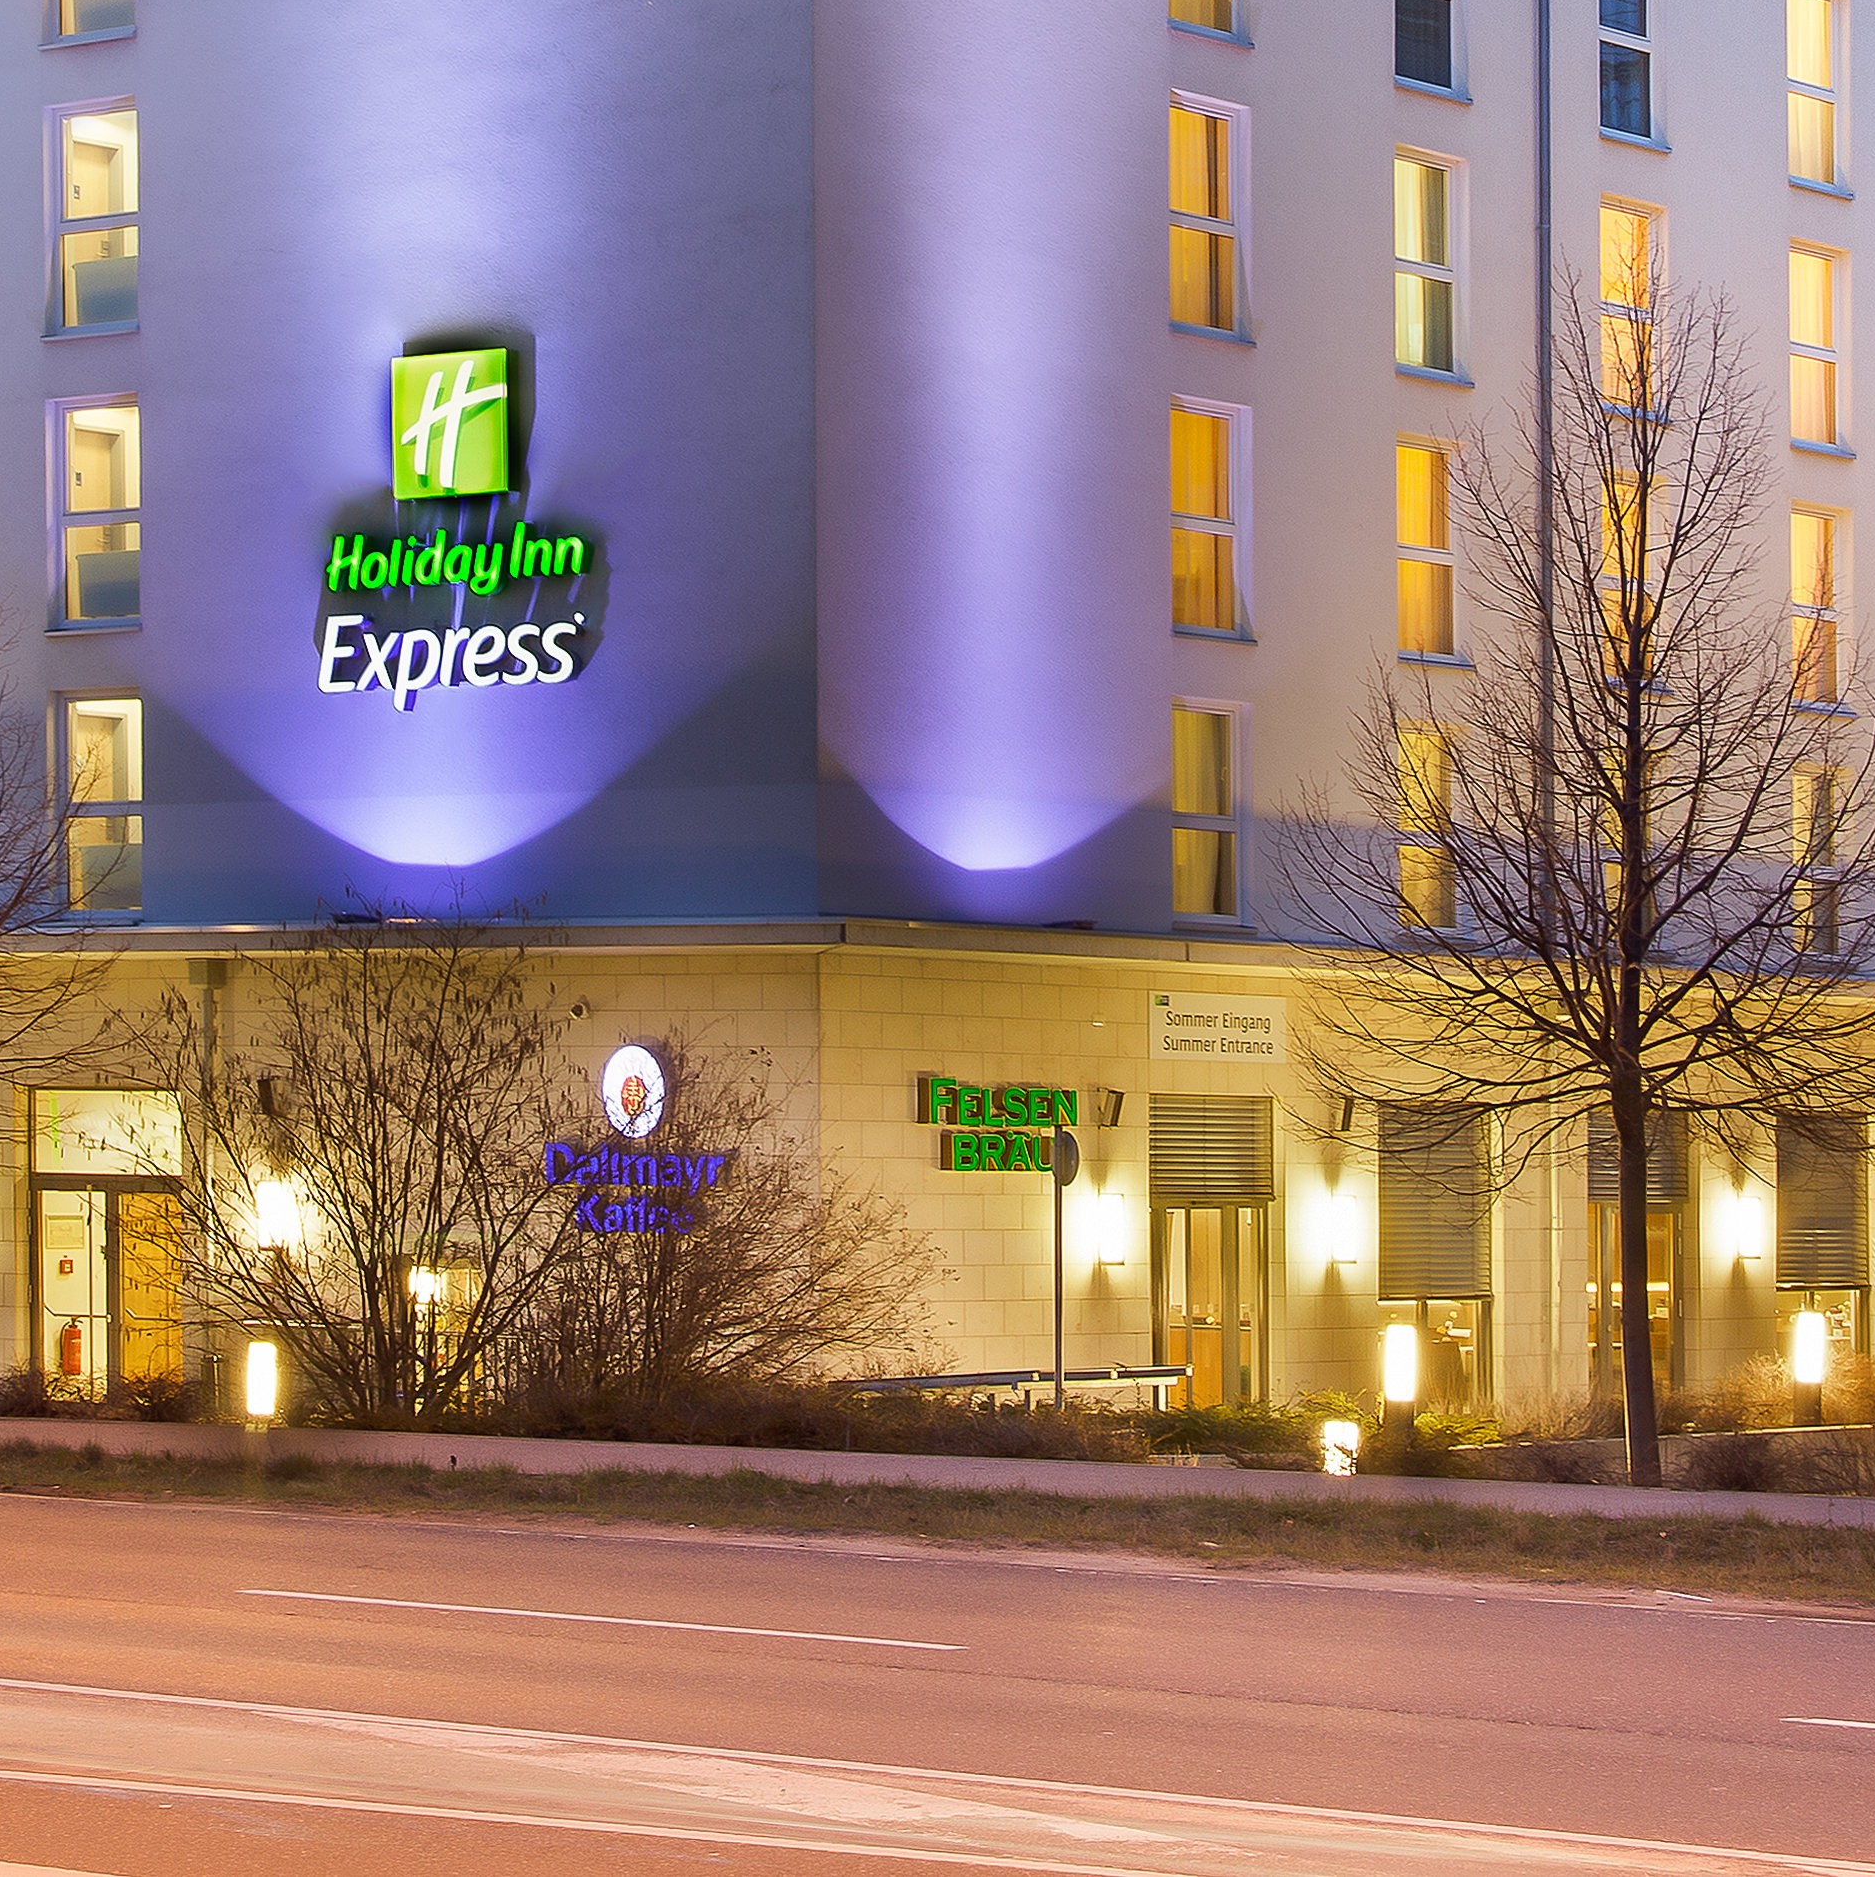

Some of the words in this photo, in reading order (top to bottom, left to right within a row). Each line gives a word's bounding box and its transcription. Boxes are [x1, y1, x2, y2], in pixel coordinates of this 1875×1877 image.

[401, 360, 507, 488] H
[326, 528, 504, 596] Holiday
[509, 521, 585, 579] Inn
[317, 612, 585, 712] Express
[1162, 1035, 1216, 1052] Summer
[1220, 1037, 1273, 1054] Entrance
[1165, 1010, 1218, 1028] Sommer
[1222, 1012, 1271, 1034] Eingang
[928, 1077, 1077, 1127] FELSEN
[544, 1141, 724, 1197] Dallmayr
[951, 1130, 1054, 1172] BRÄU
